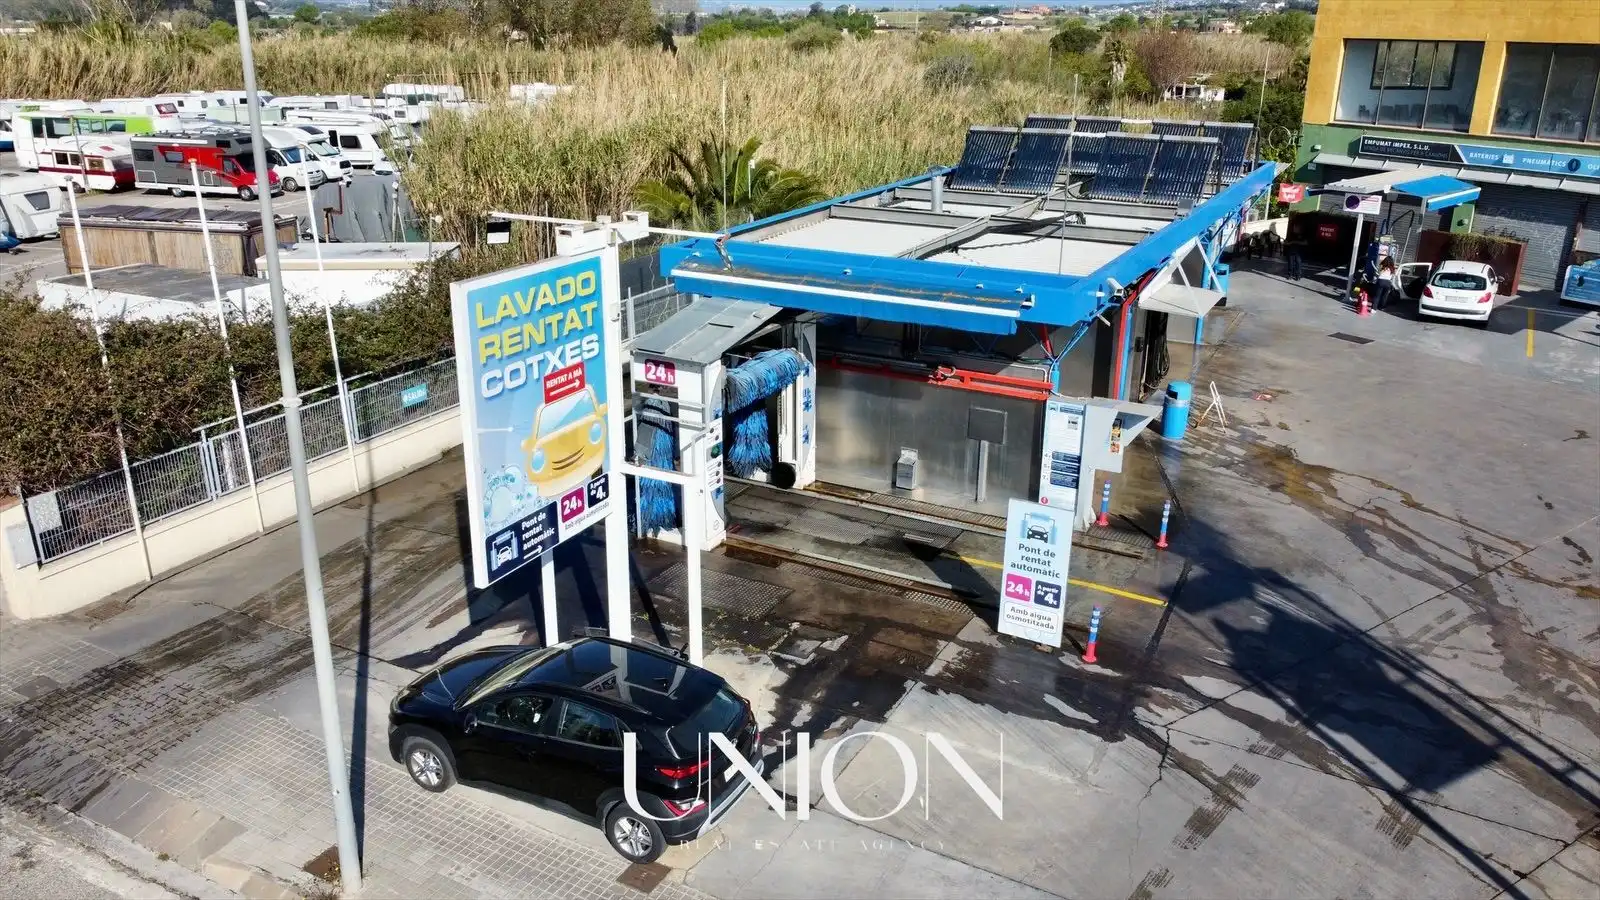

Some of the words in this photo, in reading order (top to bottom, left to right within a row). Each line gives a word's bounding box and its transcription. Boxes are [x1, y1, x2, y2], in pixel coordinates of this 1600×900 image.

[1364, 139, 1392, 147] EMPUMAT
[1469, 152, 1499, 160] BATERIES
[475, 270, 596, 329] LAVADO
[478, 301, 598, 365] RENTAT
[480, 333, 600, 399] COTXES
[646, 361, 674, 383] 24h
[546, 374, 568, 388] RENTAT
[568, 371, 573, 380] A
[521, 516, 538, 531] Pont
[537, 512, 546, 522] de
[522, 523, 543, 541] rentat
[1018, 543, 1041, 555] Pont
[1043, 549, 1056, 559] de
[1021, 555, 1051, 567] rentat
[1006, 613, 1055, 630] osmotitzada
[1010, 606, 1029, 616] Amb
[1029, 611, 1052, 622] aigua
